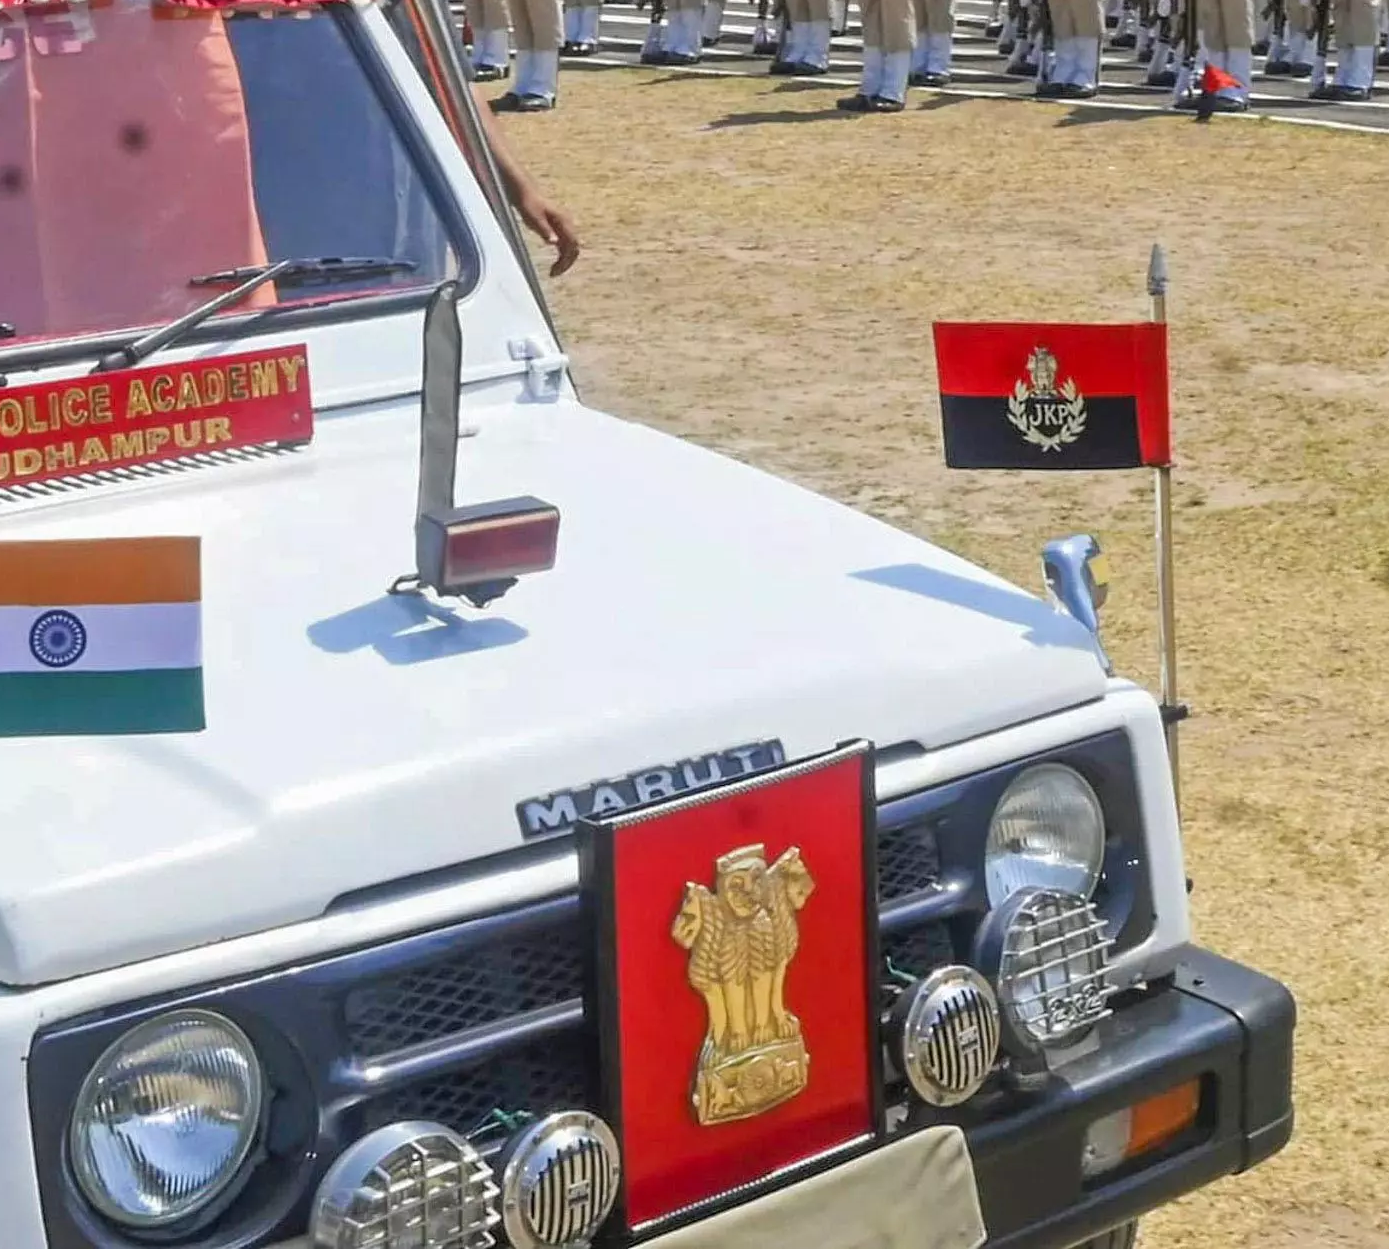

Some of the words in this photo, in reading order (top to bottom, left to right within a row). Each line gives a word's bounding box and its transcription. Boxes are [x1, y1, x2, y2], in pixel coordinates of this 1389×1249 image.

[126, 354, 306, 418] ACADEMY
[1029, 404, 1069, 426] JKP
[523, 740, 784, 833] MARUTI
